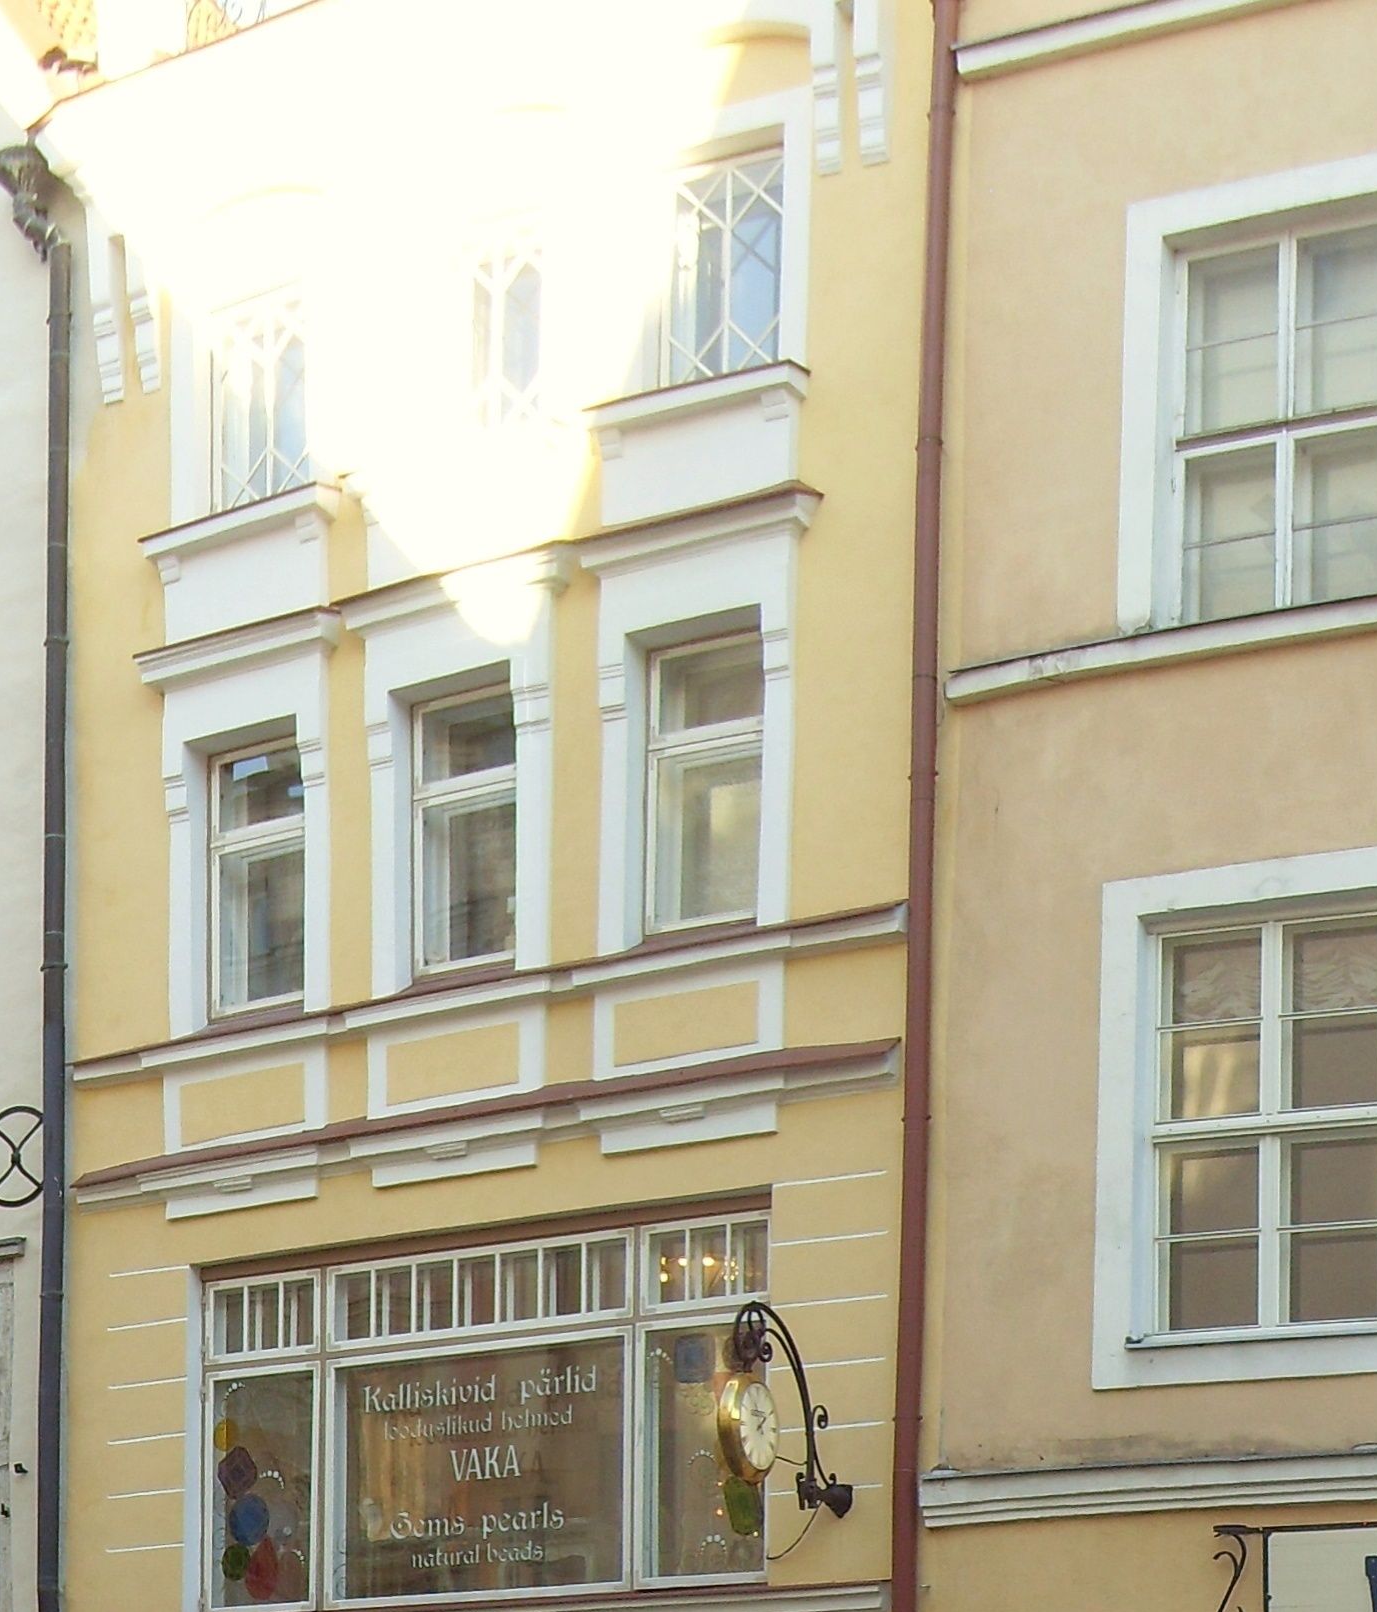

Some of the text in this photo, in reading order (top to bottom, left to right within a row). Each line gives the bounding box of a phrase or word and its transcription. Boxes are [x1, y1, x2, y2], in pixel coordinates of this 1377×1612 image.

[363, 1364, 598, 1413] Kalliskivid pärlid
[450, 1444, 521, 1482] VAKA
[389, 1501, 566, 1540] Gems pearls
[411, 1540, 544, 1569] natural beads
